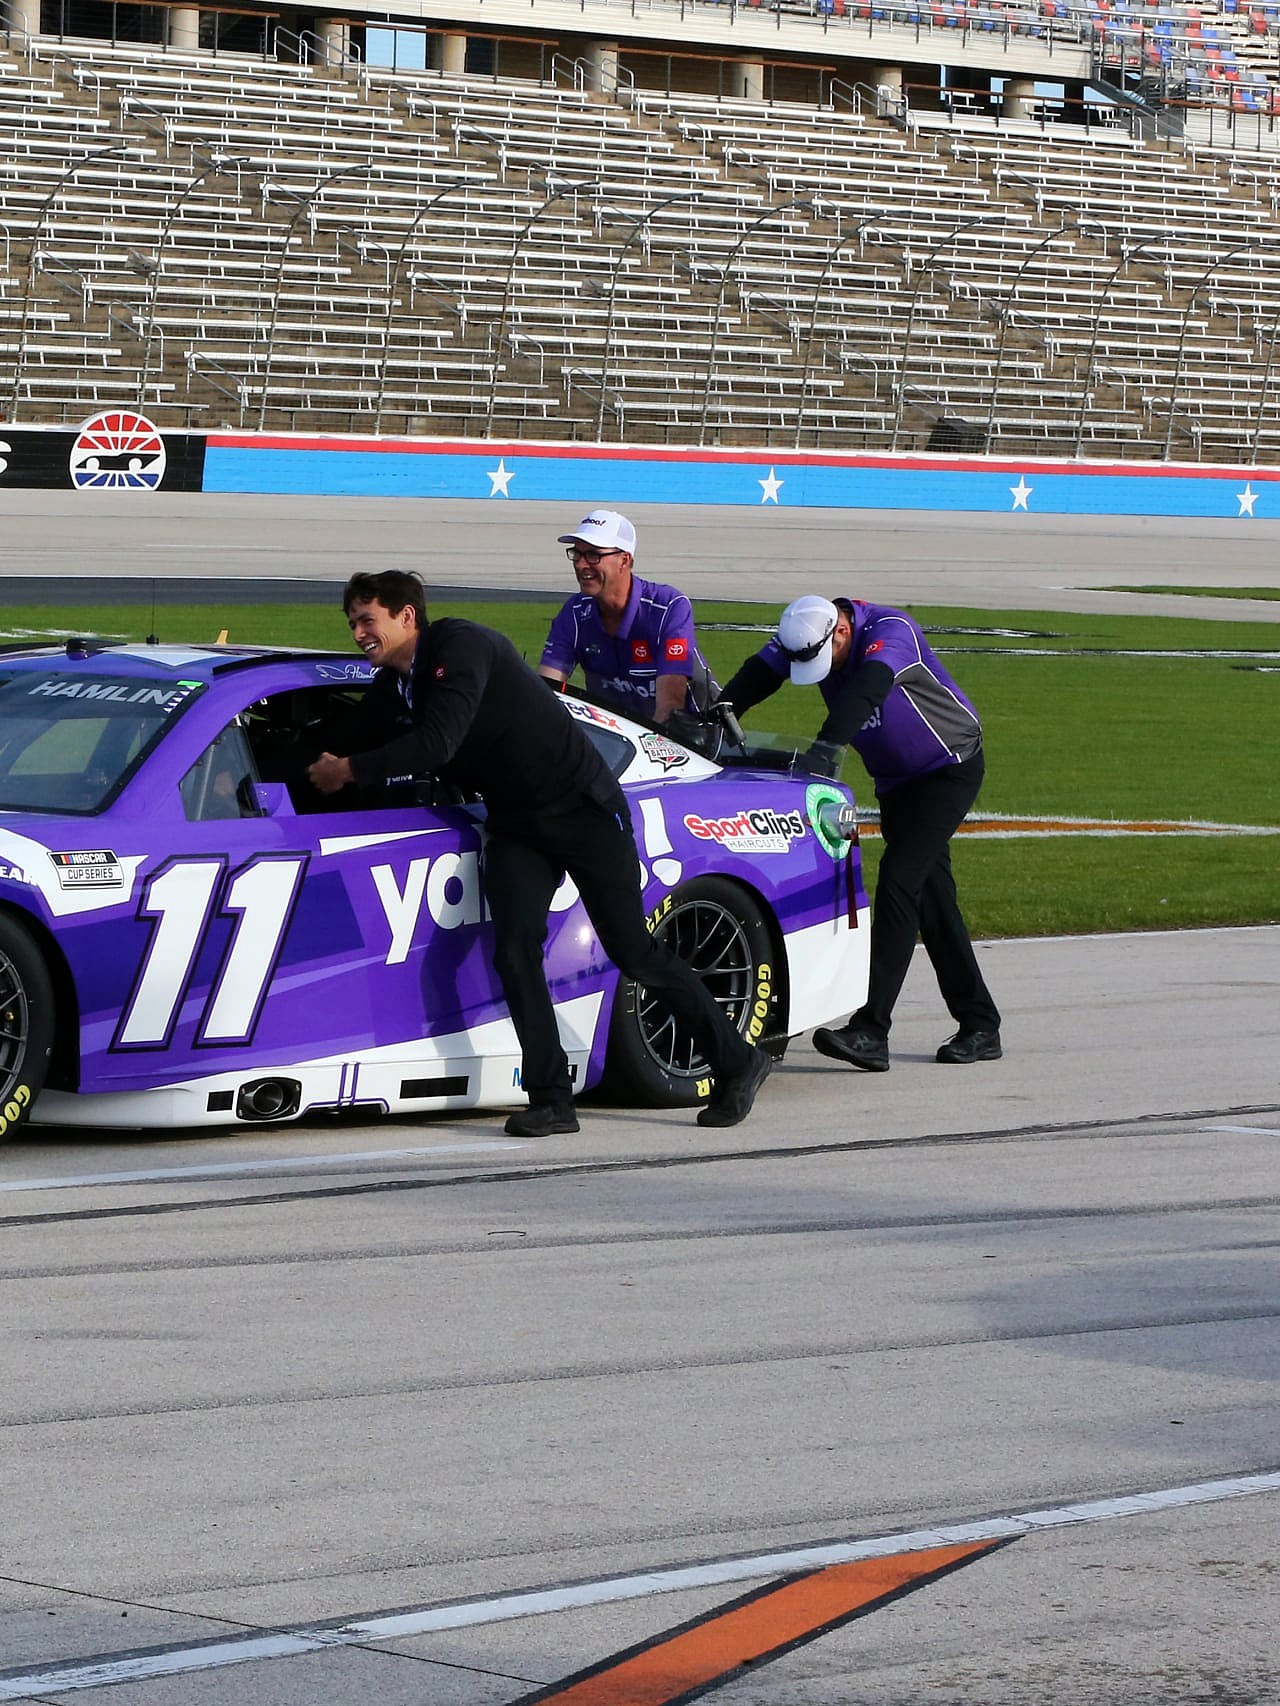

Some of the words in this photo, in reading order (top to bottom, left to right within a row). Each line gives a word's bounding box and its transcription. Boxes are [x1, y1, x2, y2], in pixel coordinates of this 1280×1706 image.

[28, 681, 177, 705] HAMLIN
[728, 839, 785, 849] HAIRCUTS
[71, 853, 108, 863] NASCAR
[68, 869, 85, 880] CUP
[86, 867, 114, 879] SERIES
[114, 856, 307, 1050] 11
